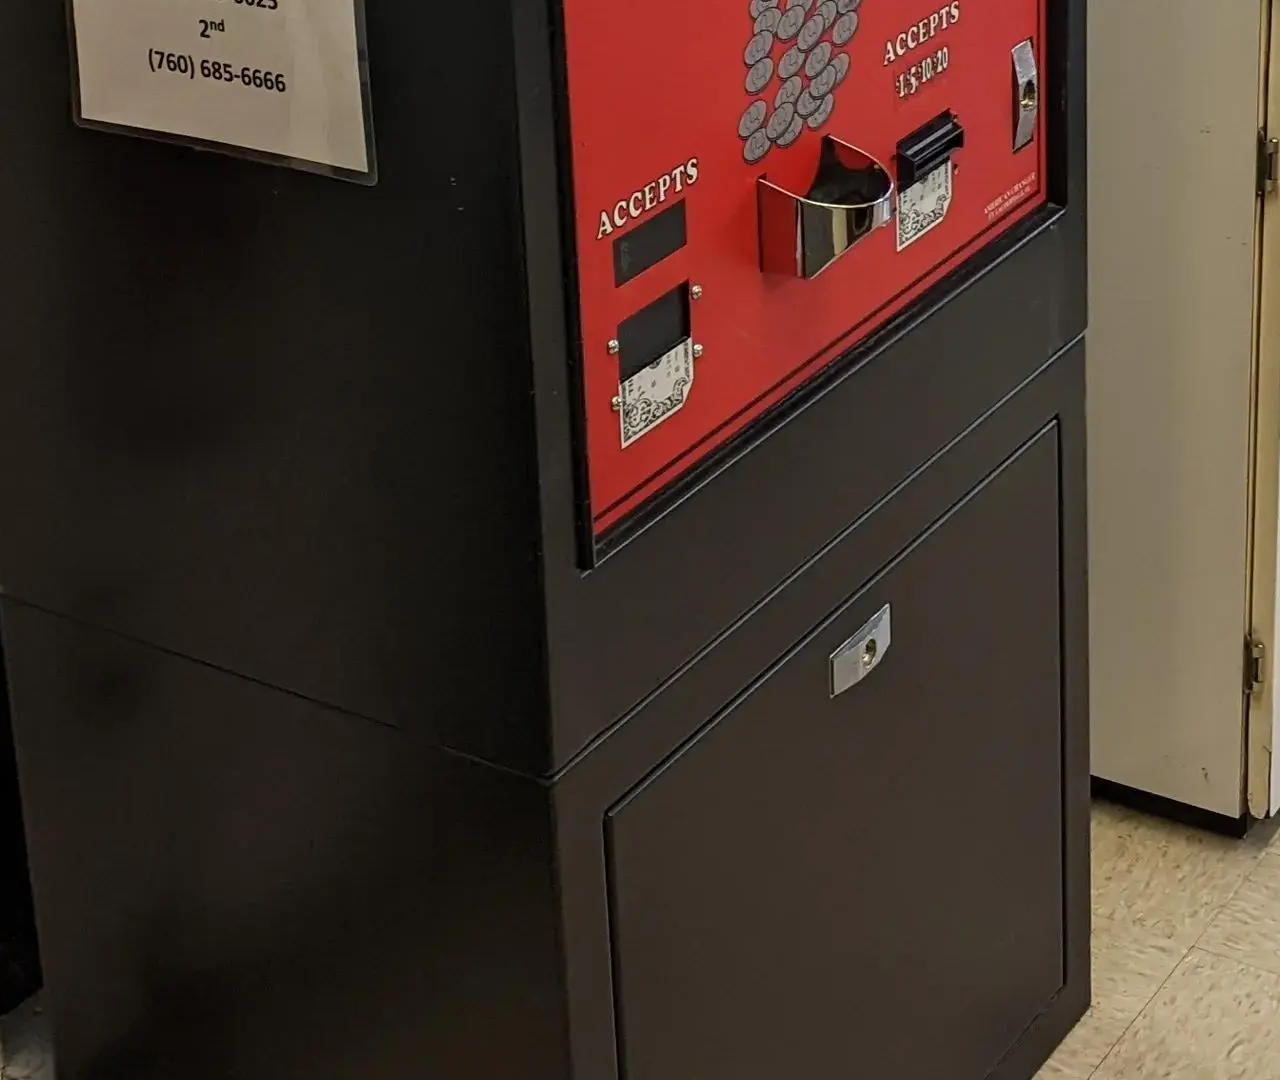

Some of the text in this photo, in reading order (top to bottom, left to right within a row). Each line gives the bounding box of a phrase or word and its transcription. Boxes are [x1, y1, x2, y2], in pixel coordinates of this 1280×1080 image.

[198, 18, 226, 39] 2nd
[883, 0, 960, 67] ACCEPTS
[148, 48, 287, 94] (760) 685-6666
[596, 156, 700, 241] ACCEPTS
